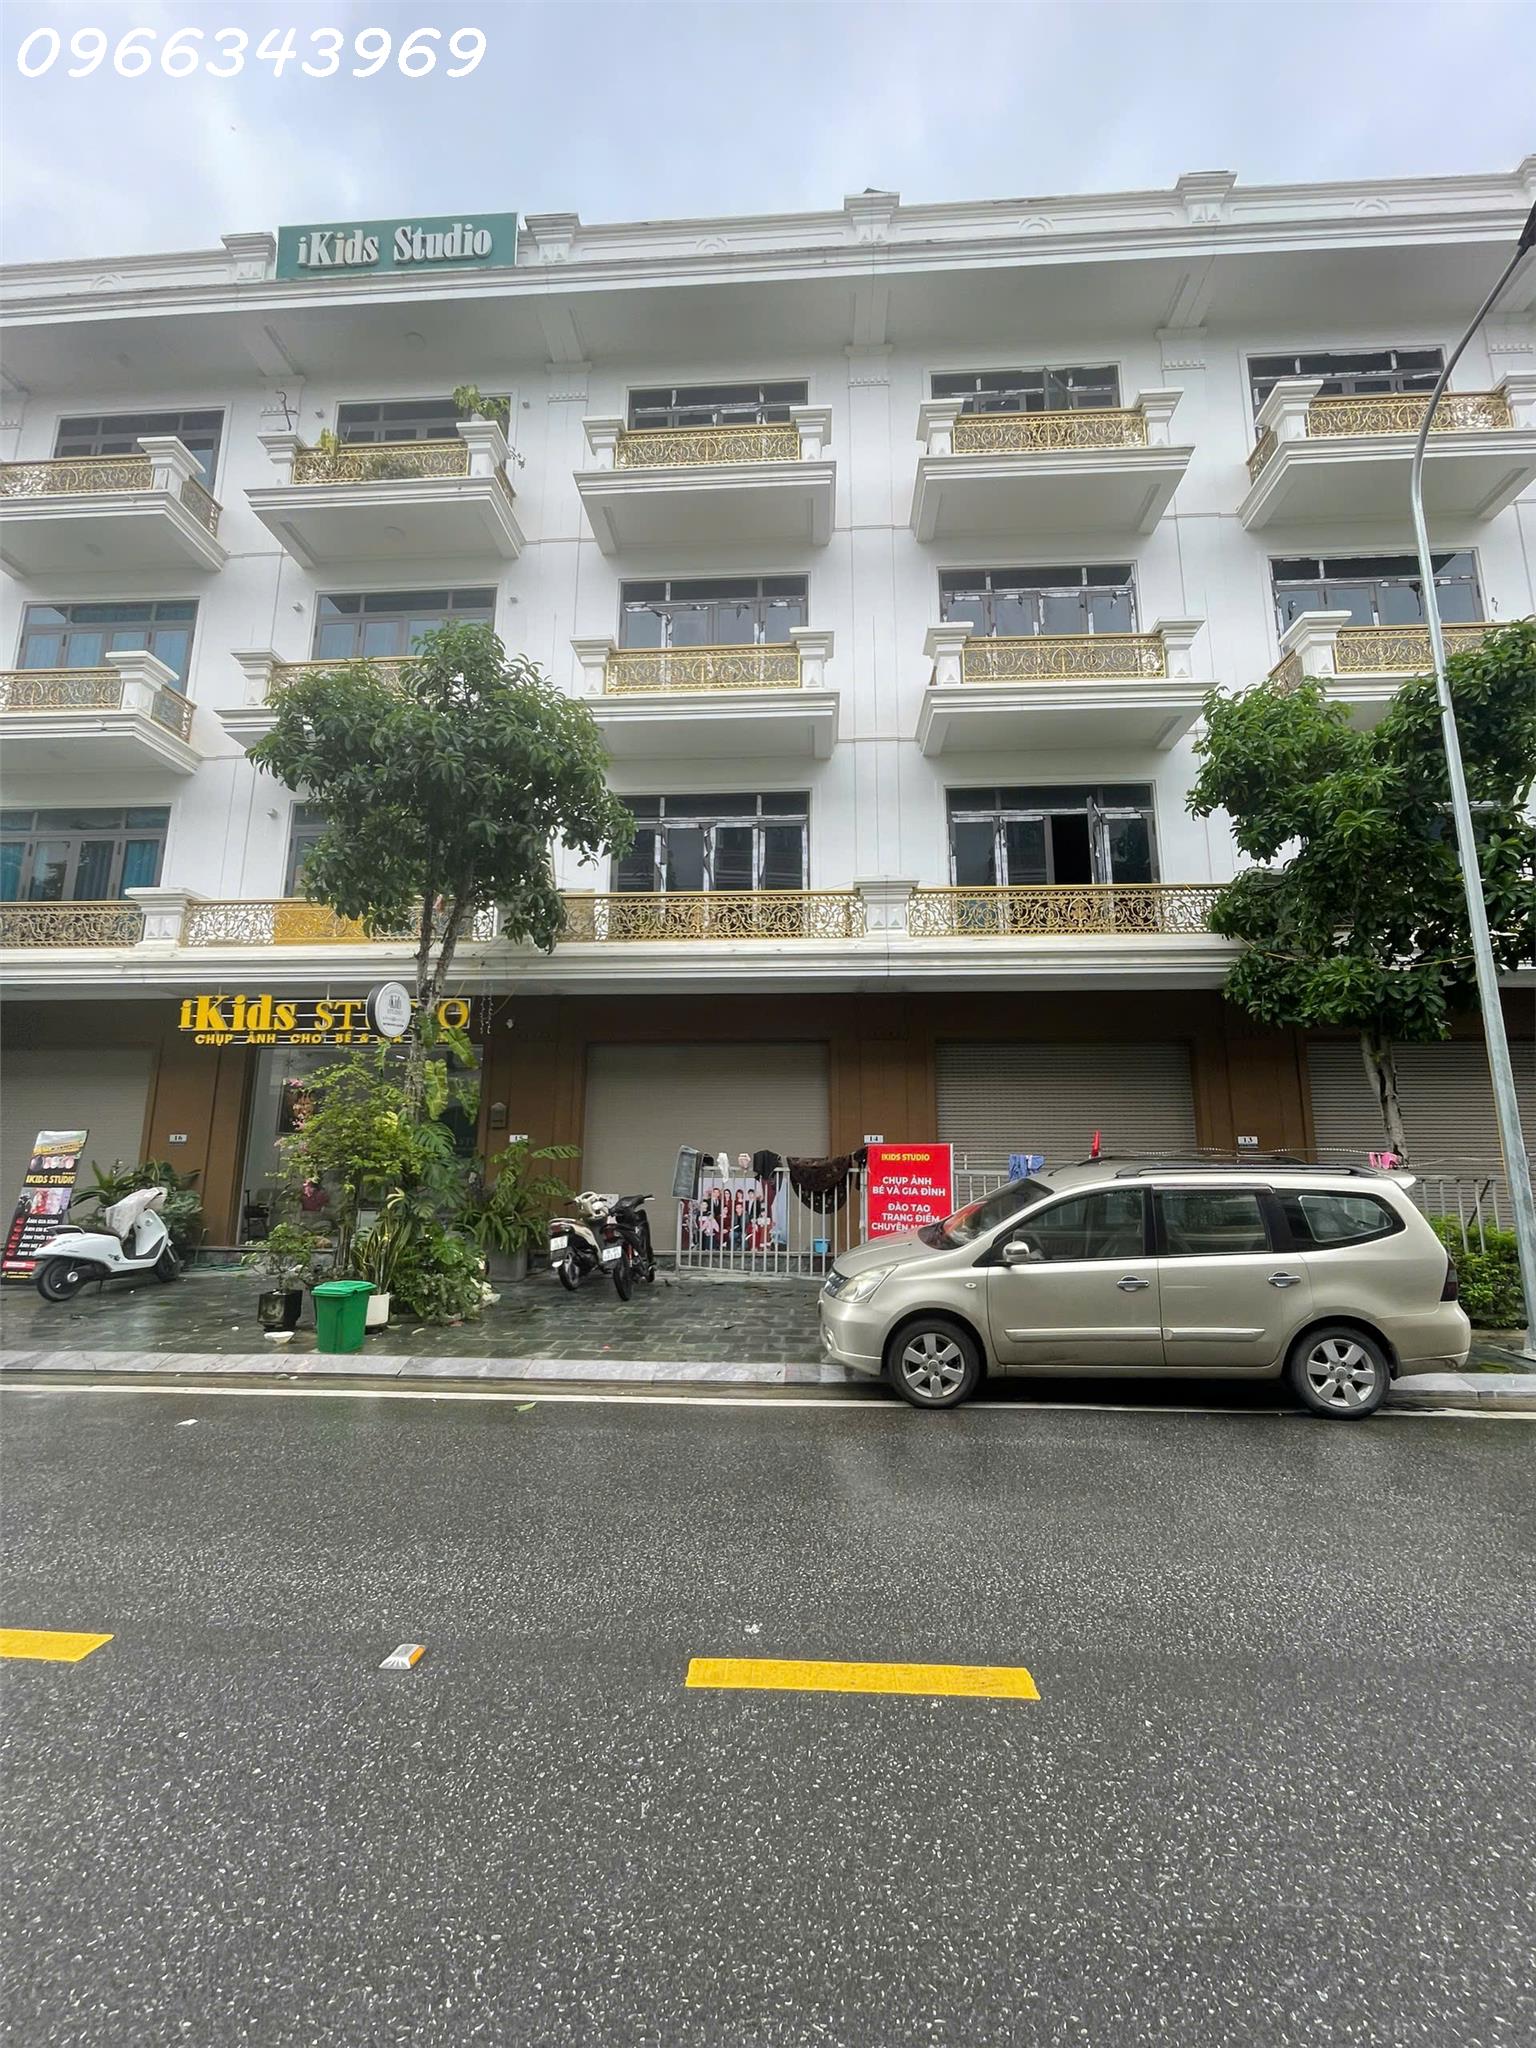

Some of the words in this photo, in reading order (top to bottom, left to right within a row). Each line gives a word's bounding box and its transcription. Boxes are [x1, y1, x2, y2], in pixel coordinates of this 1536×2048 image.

[297, 230, 380, 267] iKids
[393, 223, 492, 263] Studio
[178, 993, 298, 1031] iKids
[314, 1000, 470, 1031] STO
[195, 1033, 234, 1046] CHỤP
[290, 1034, 322, 1044] CHO
[336, 1031, 352, 1043] BÉ
[902, 1153, 930, 1161] STUDIO
[49, 1175, 76, 1184] STUDIO
[882, 1176, 908, 1186] CHỤP
[911, 1174, 932, 1185] ẢNH
[872, 1185, 884, 1194] BÉ
[886, 1185, 900, 1194] VÀ
[902, 1187, 918, 1195] GIA
[920, 1186, 946, 1196] ĐÌNH
[888, 1201, 909, 1211] ĐÀO
[882, 1213, 913, 1222] TRANG
